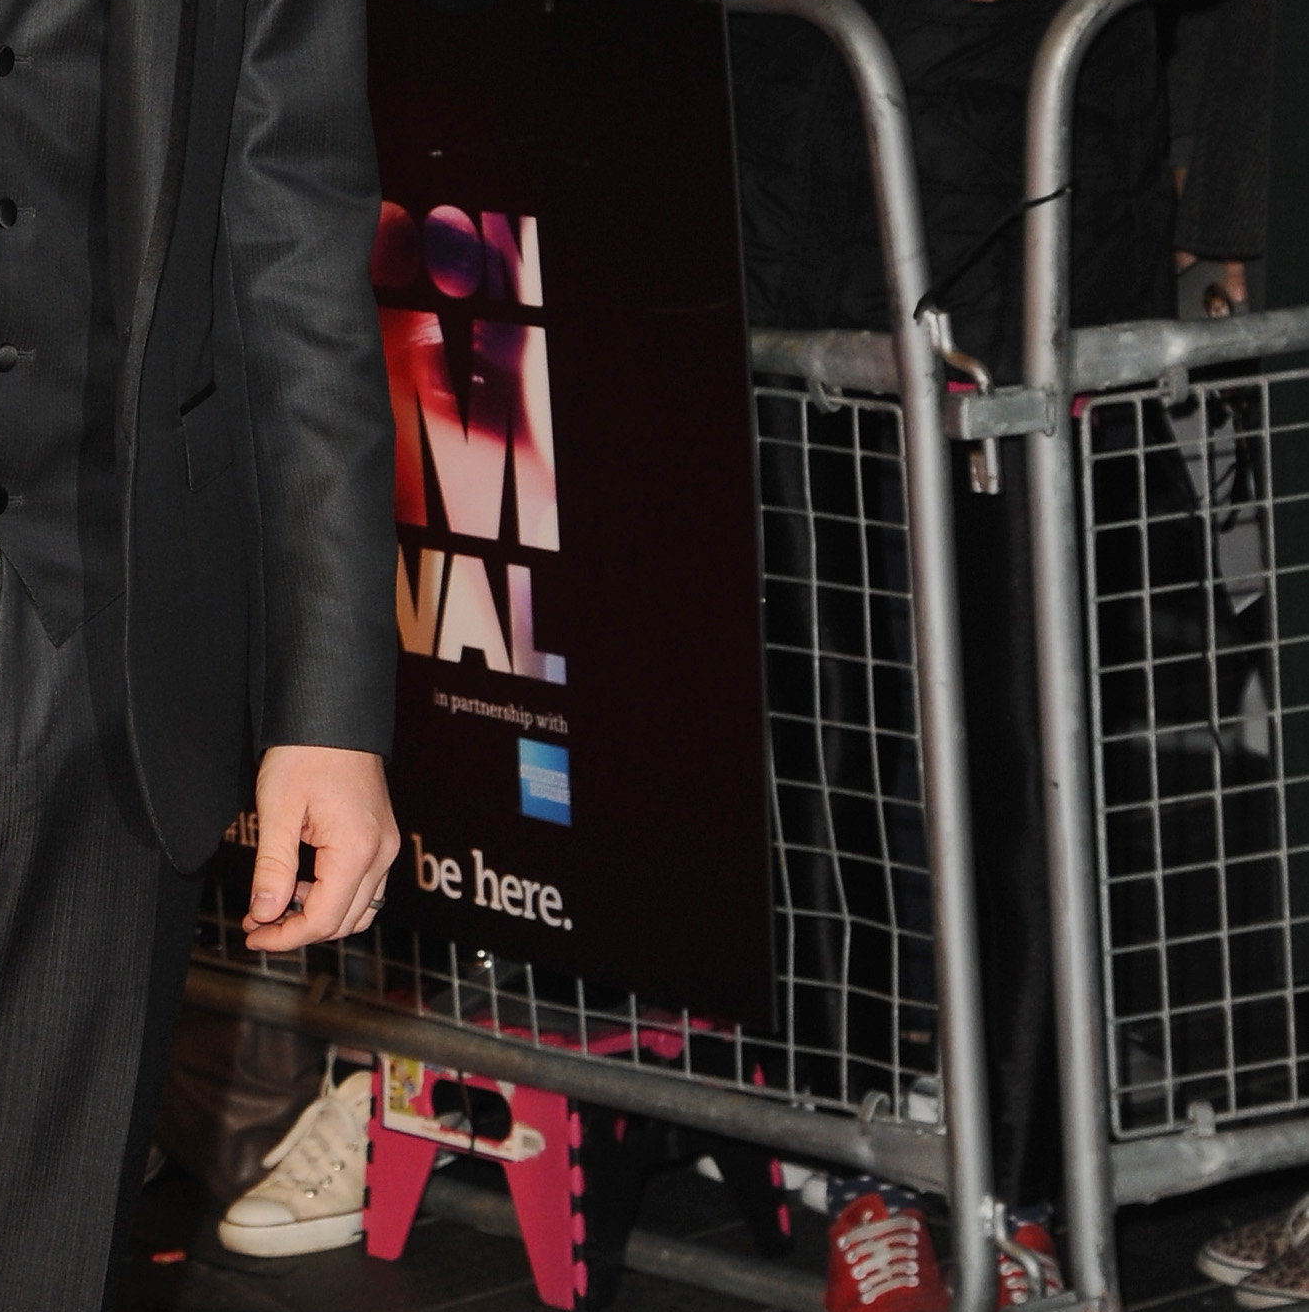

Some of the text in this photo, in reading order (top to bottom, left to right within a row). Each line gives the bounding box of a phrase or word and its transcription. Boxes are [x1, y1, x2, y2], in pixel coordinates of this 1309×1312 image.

[433, 687, 569, 735] in partnership with
[411, 832, 573, 931] be here.
